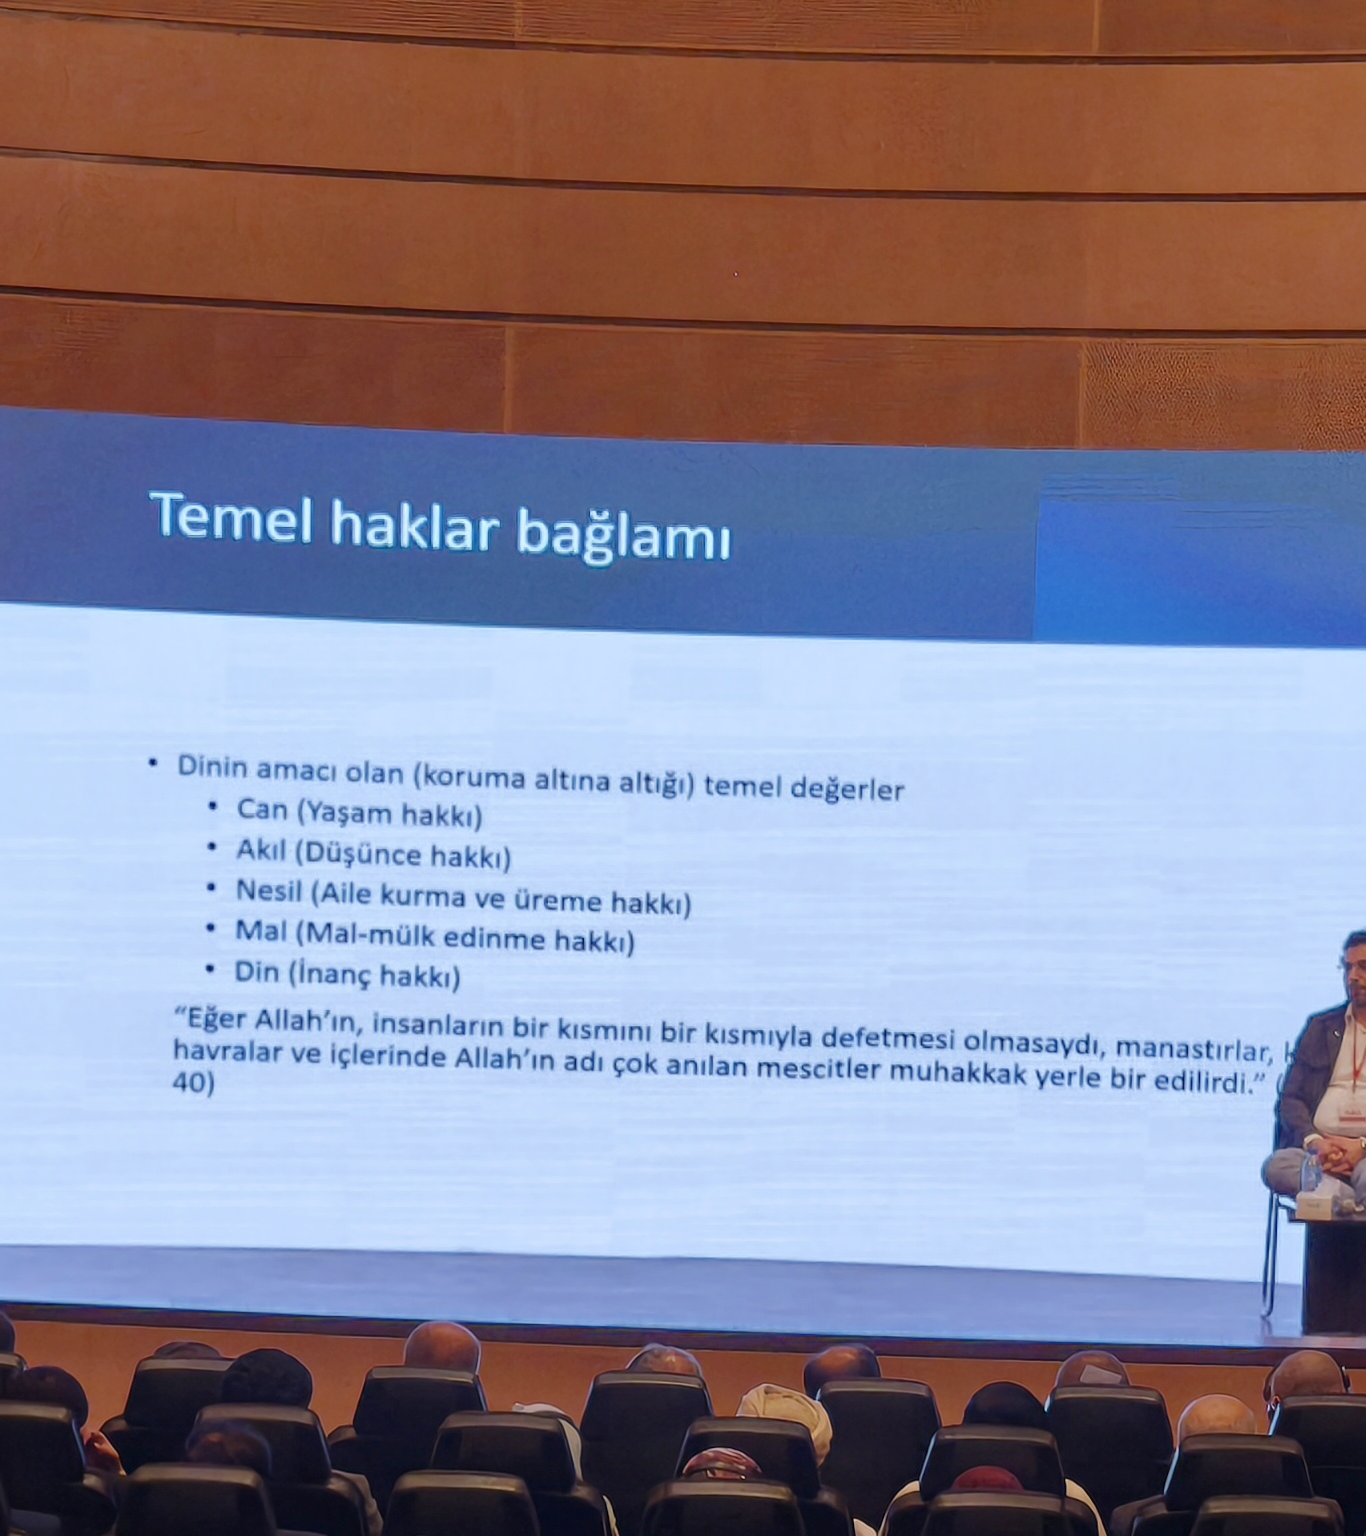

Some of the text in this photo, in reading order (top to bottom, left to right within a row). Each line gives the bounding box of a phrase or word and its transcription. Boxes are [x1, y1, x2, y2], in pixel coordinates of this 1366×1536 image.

[148, 491, 730, 567] Temel haklar bağlamı
[178, 754, 905, 806] Dinin amacı olan (koruma altına altığı) temel değerler
[237, 797, 483, 833] Can (Yaşam hakkı)
[236, 837, 511, 874] Akıl (Düşünce hakkı)
[236, 878, 692, 921] Nesil (Aile kurma ve üreme hakkı)
[236, 918, 635, 958] Mal (Mal-mülk edinme hakkı)
[235, 957, 461, 994] Din (İnanç hakkı)
[174, 1005, 247, 1034] “Eğer
[254, 1008, 363, 1037] Allah’ın,
[373, 1012, 504, 1037] insanların
[513, 1016, 550, 1038] bir
[558, 1017, 651, 1042] kısmını
[661, 1020, 698, 1044] bir
[705, 1021, 813, 1052] kısmıyla
[821, 1026, 955, 1050] defetmesi
[963, 1029, 1106, 1060] olmasaydı,
[1116, 1039, 1274, 1067] manastırlar,
[172, 1070, 215, 1098] 40)
[173, 1037, 283, 1063] havralar
[291, 1046, 322, 1064] ve
[330, 1042, 447, 1070] içlerinde
[454, 1046, 555, 1071] Allah’ın
[563, 1050, 603, 1072] adı
[612, 1052, 658, 1079] çok
[666, 1054, 748, 1077] anılan
[757, 1057, 882, 1080] mescitler
[890, 1059, 1027, 1086] muhakkak
[1035, 1065, 1101, 1091] yerle
[1110, 1067, 1147, 1090] bir
[1154, 1069, 1266, 1095] edilirdi.”
